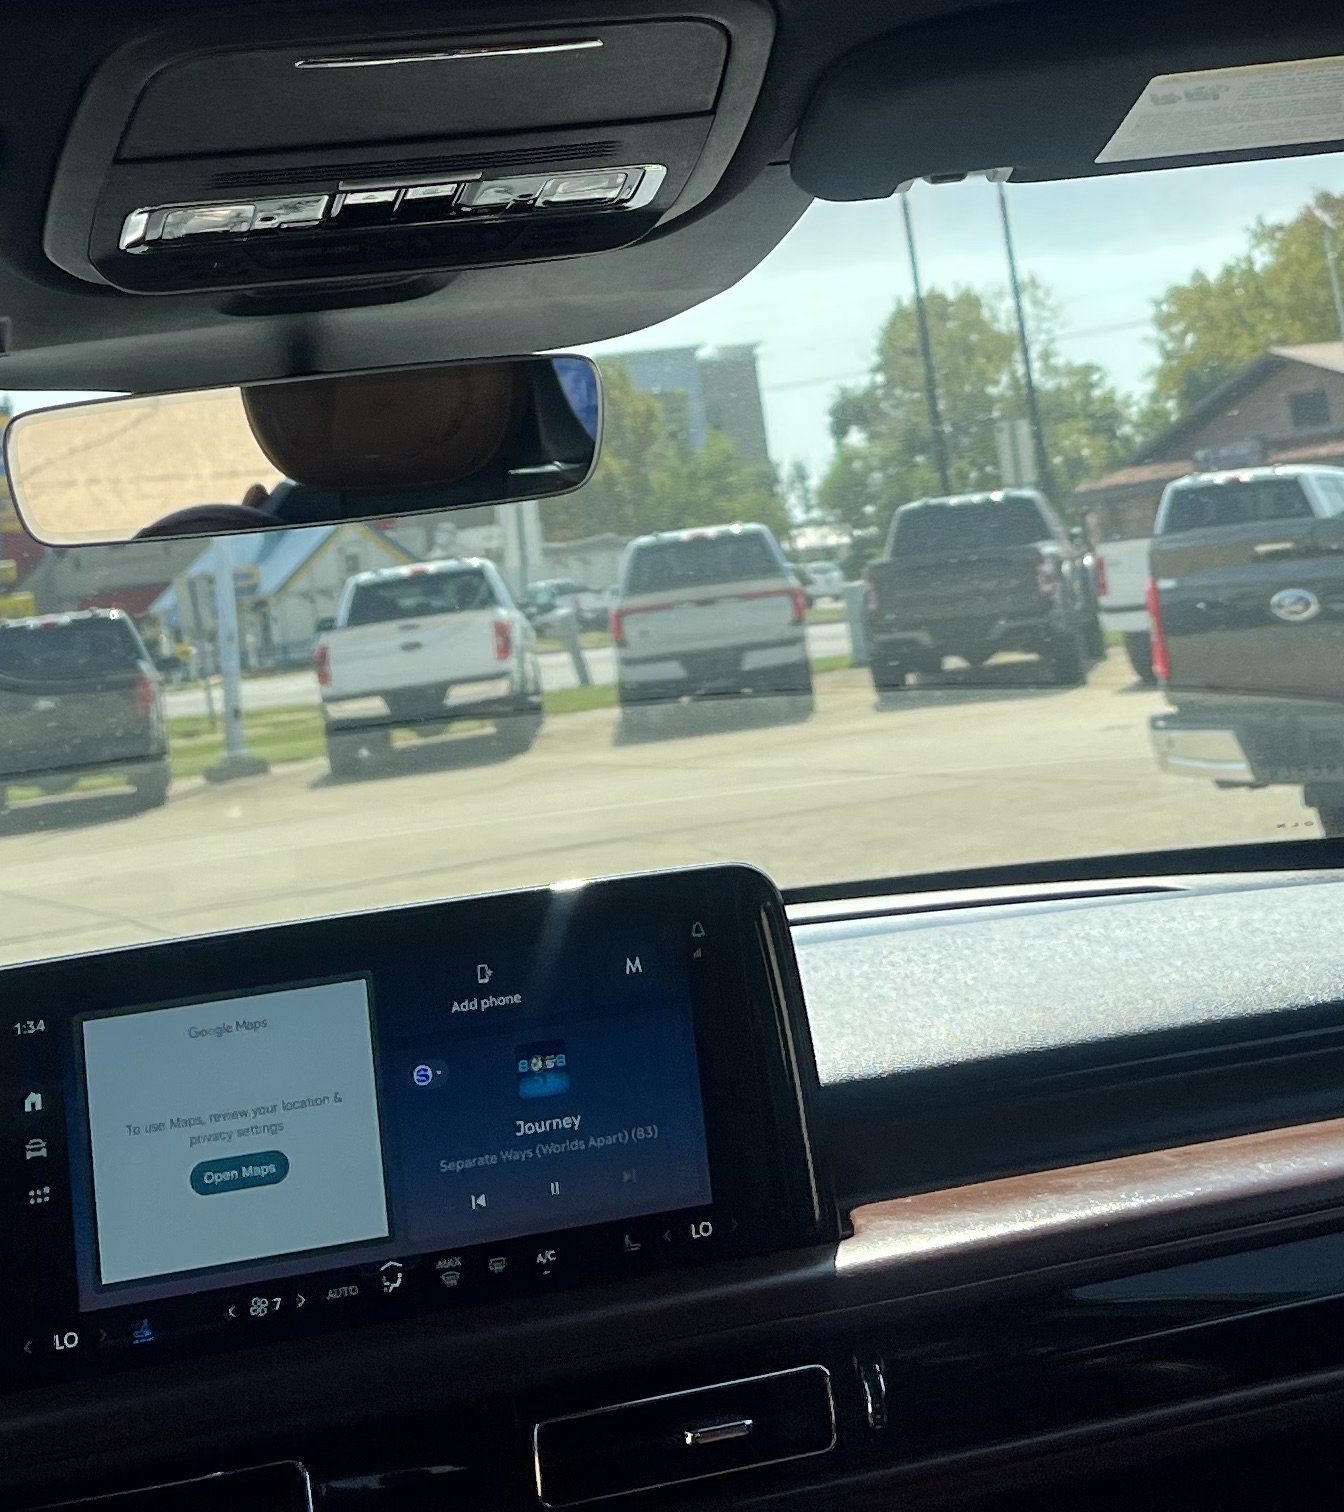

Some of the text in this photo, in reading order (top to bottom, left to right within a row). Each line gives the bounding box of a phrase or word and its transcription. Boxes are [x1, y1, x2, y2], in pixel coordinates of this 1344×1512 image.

[625, 956, 643, 975] M
[451, 992, 523, 1013] Add phone
[14, 1020, 46, 1035] 1:34
[188, 1018, 268, 1039] Google Maps
[126, 1092, 343, 1136] To use Maps, review your location &
[189, 1121, 284, 1147] privacy settings
[515, 1113, 582, 1137] Journey
[439, 1124, 659, 1173] Separate Ways (Worlds Apart) (83)
[203, 1161, 276, 1185] Open Maps
[691, 1221, 713, 1239] LO
[536, 1249, 556, 1264] A/C
[326, 1285, 358, 1300] AUTO
[273, 1297, 282, 1311] 7
[54, 1332, 79, 1350] LO
